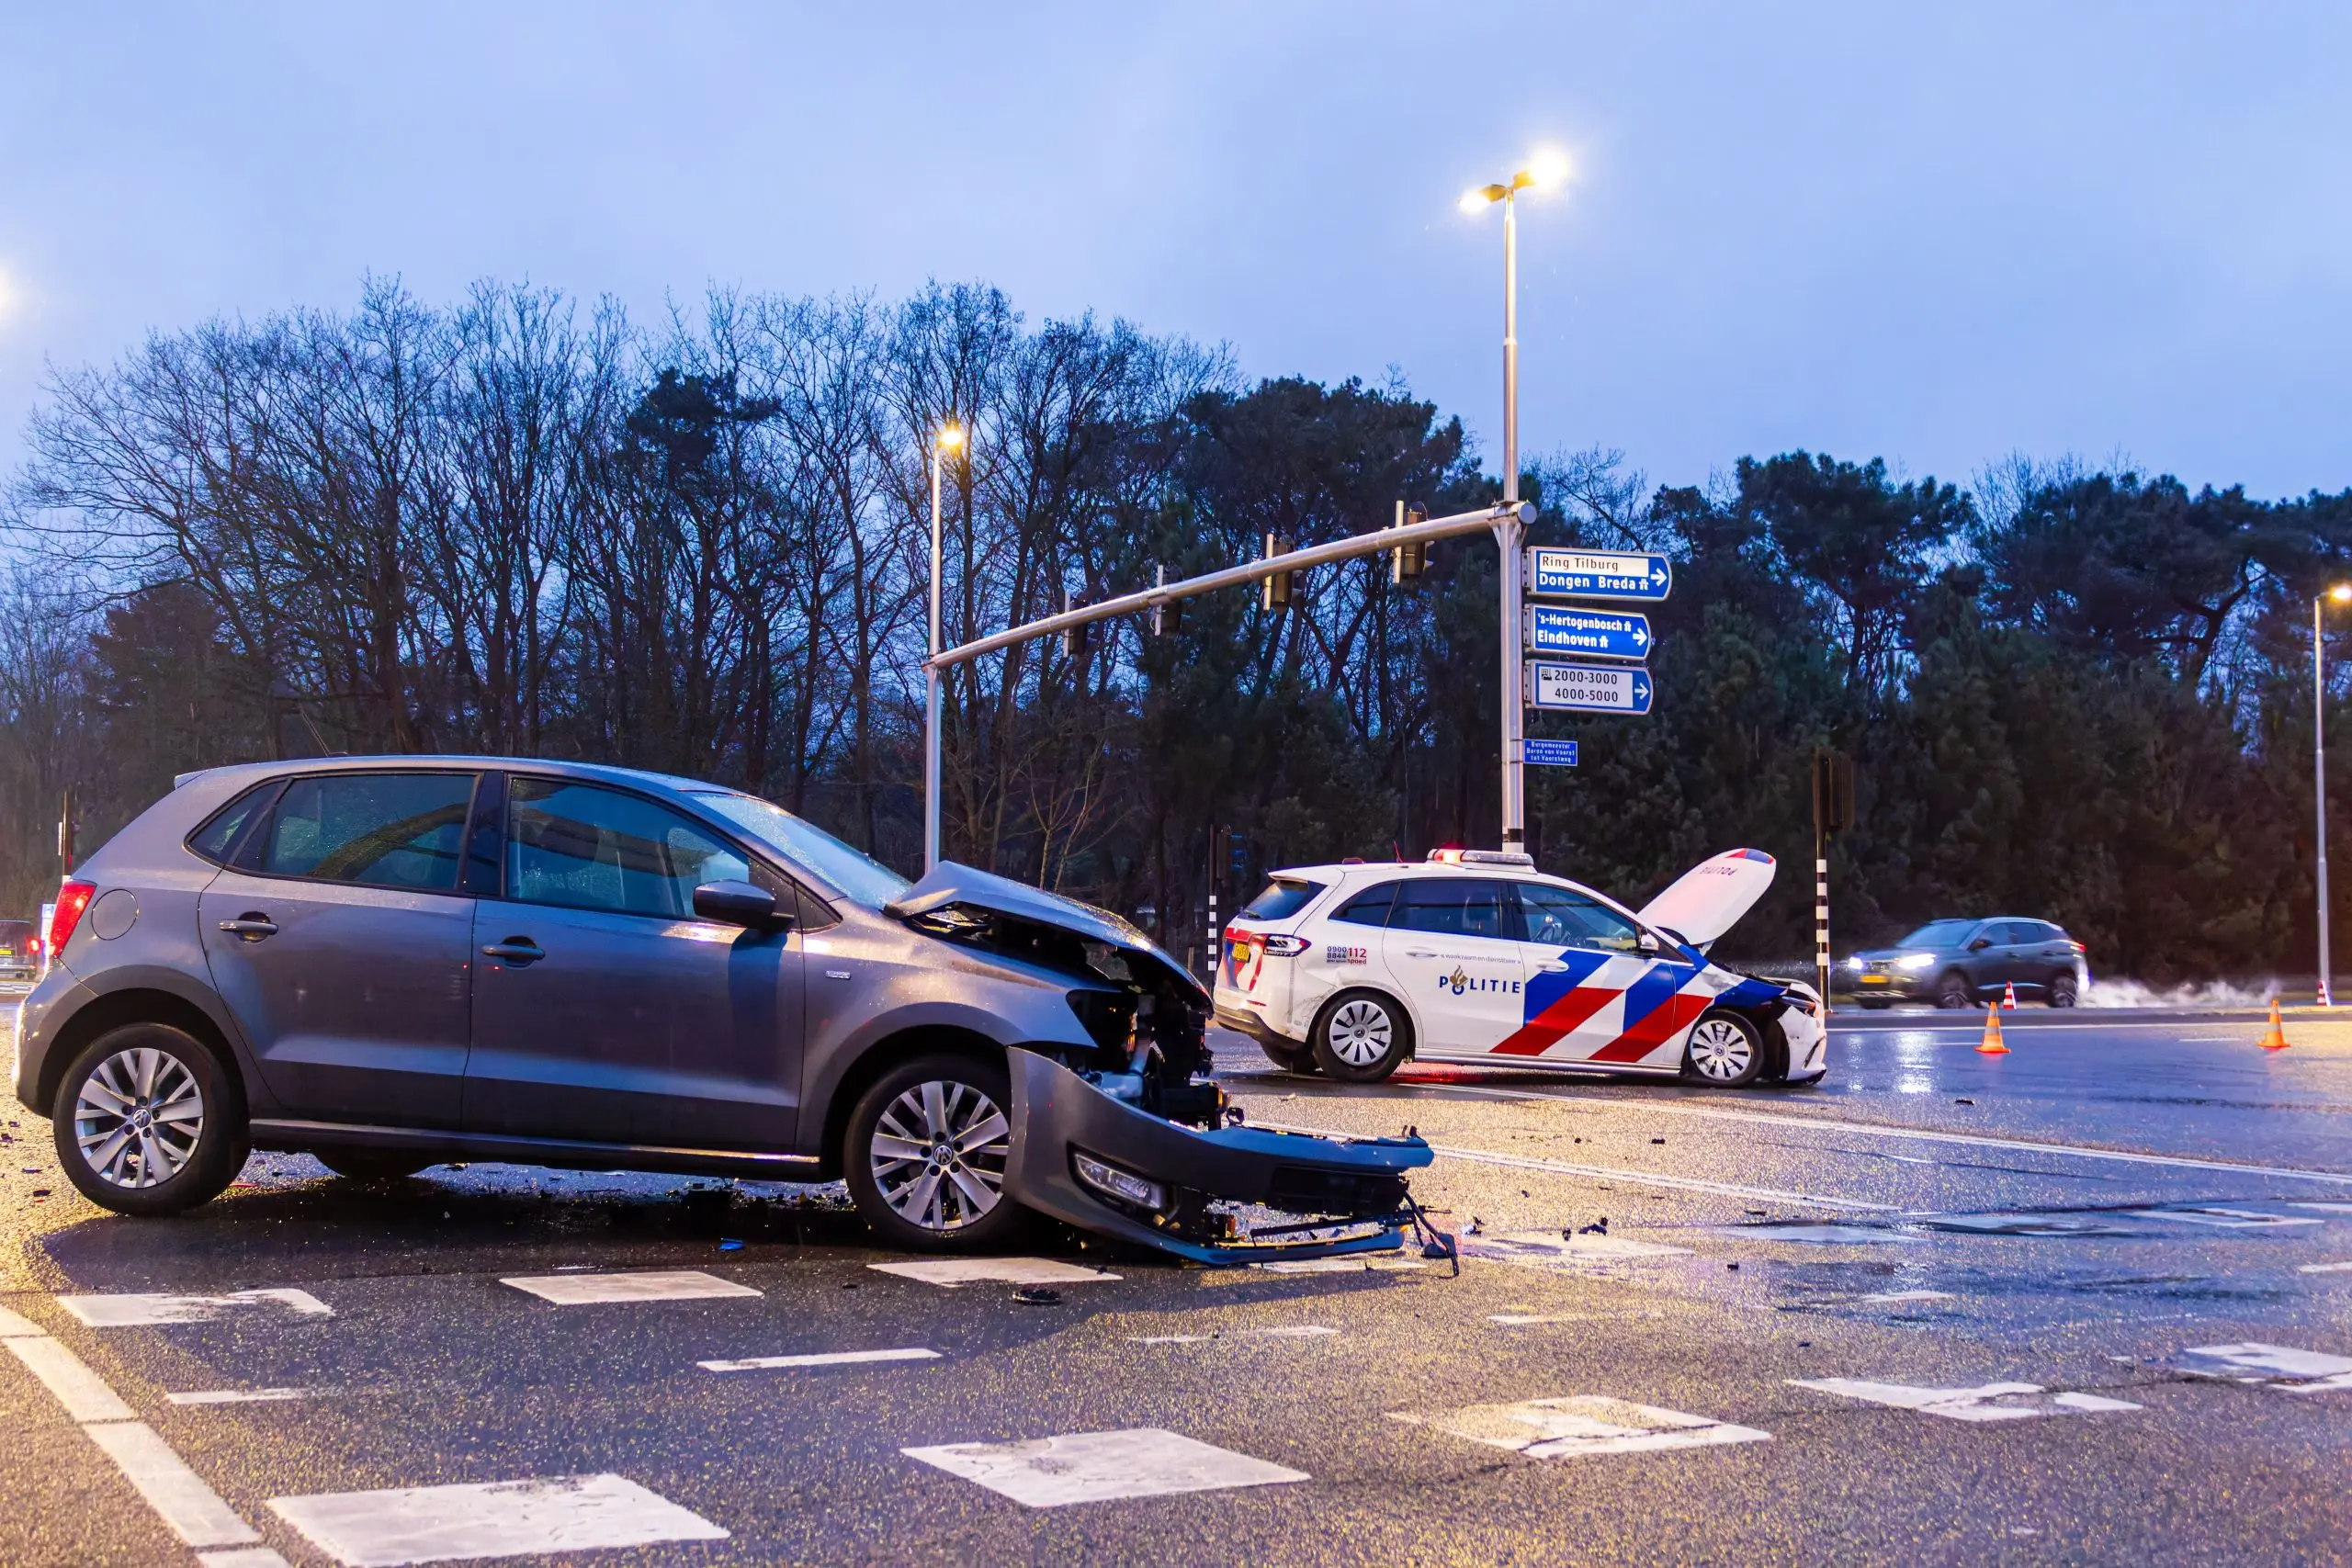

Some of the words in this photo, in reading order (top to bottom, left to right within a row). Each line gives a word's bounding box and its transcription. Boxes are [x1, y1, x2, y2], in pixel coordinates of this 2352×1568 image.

[1543, 556, 1569, 570] Ring
[1574, 558, 1619, 572] Tilburg
[1539, 573, 1589, 590] Dongen
[1599, 577, 1635, 590] Breda
[1537, 613, 1623, 631] 's-Hertogenbosch
[1537, 629, 1597, 647] Eindhoven
[1555, 670, 1618, 684] 2000-3000
[1555, 688, 1618, 702] 4000-5000
[1348, 947, 1367, 958] 112
[1439, 976, 1521, 995] POLITIE
